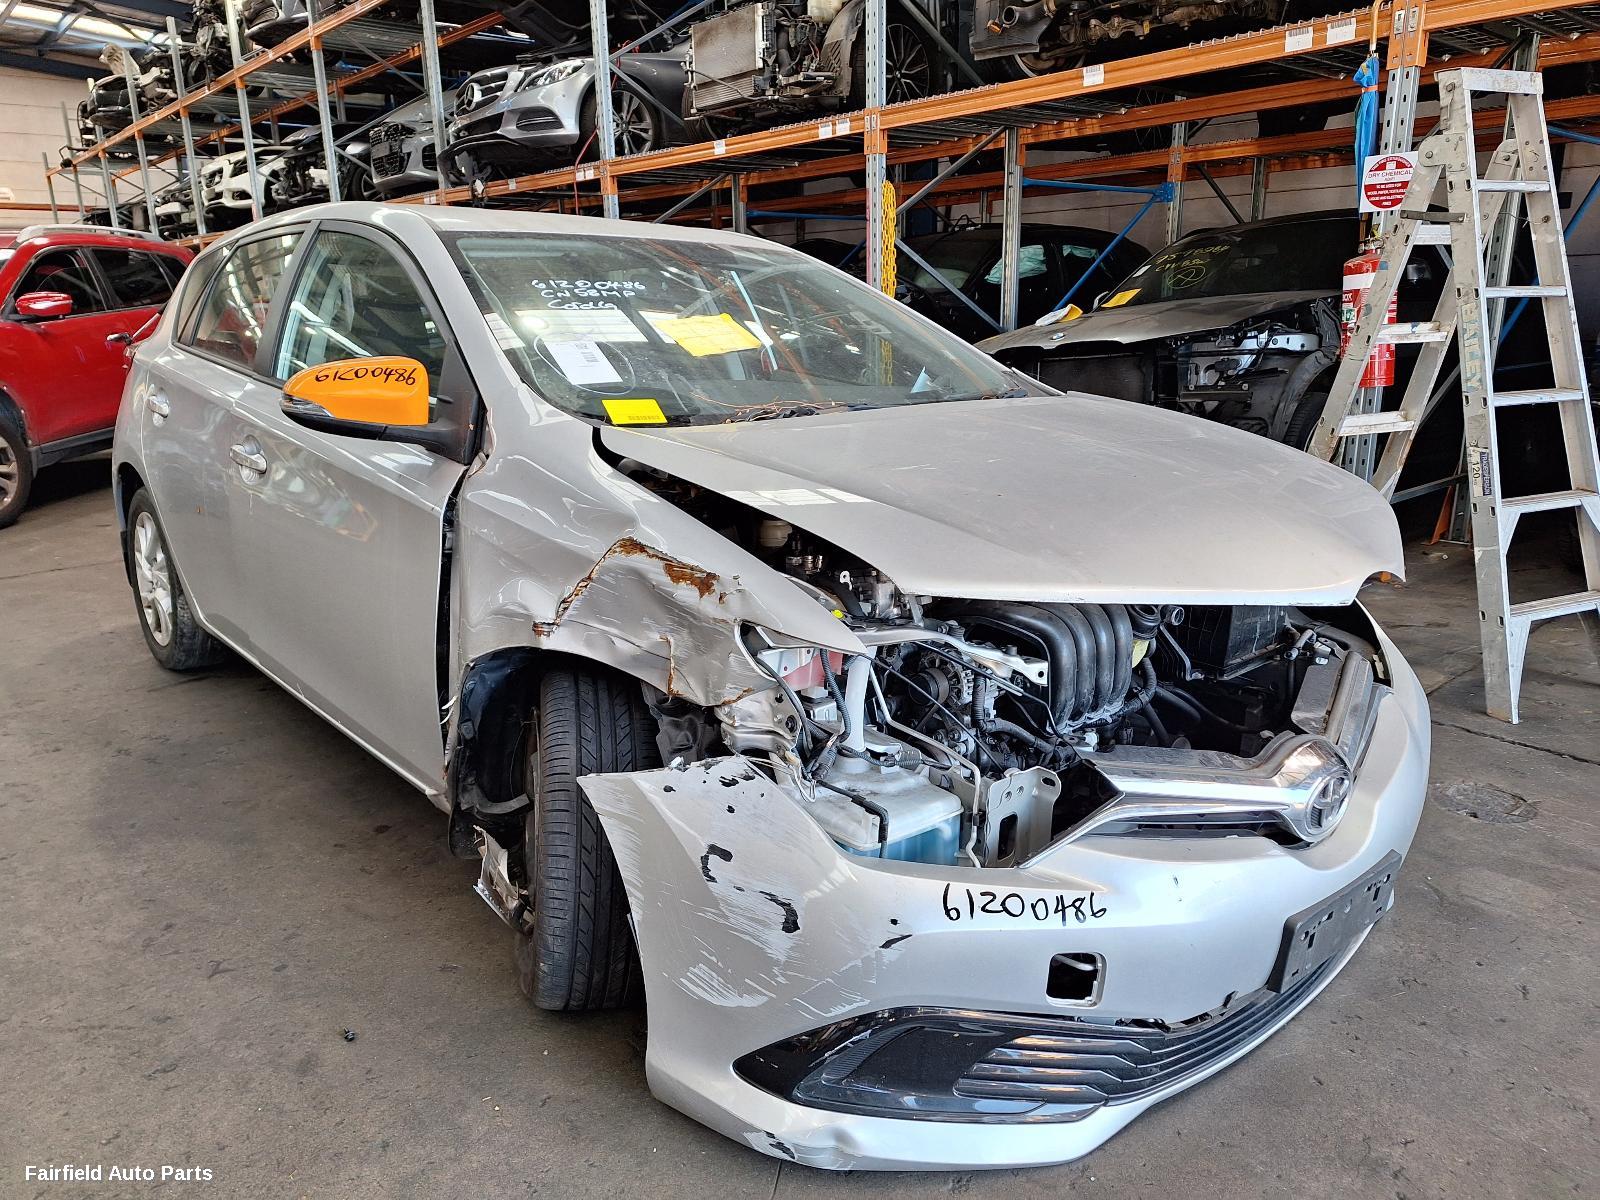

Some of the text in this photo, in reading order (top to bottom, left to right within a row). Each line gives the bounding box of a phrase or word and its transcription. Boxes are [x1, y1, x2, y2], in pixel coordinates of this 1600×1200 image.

[1381, 169, 1412, 177] CHEMICAL
[1472, 461, 1480, 479] 120
[942, 882, 1107, 927] 61200486
